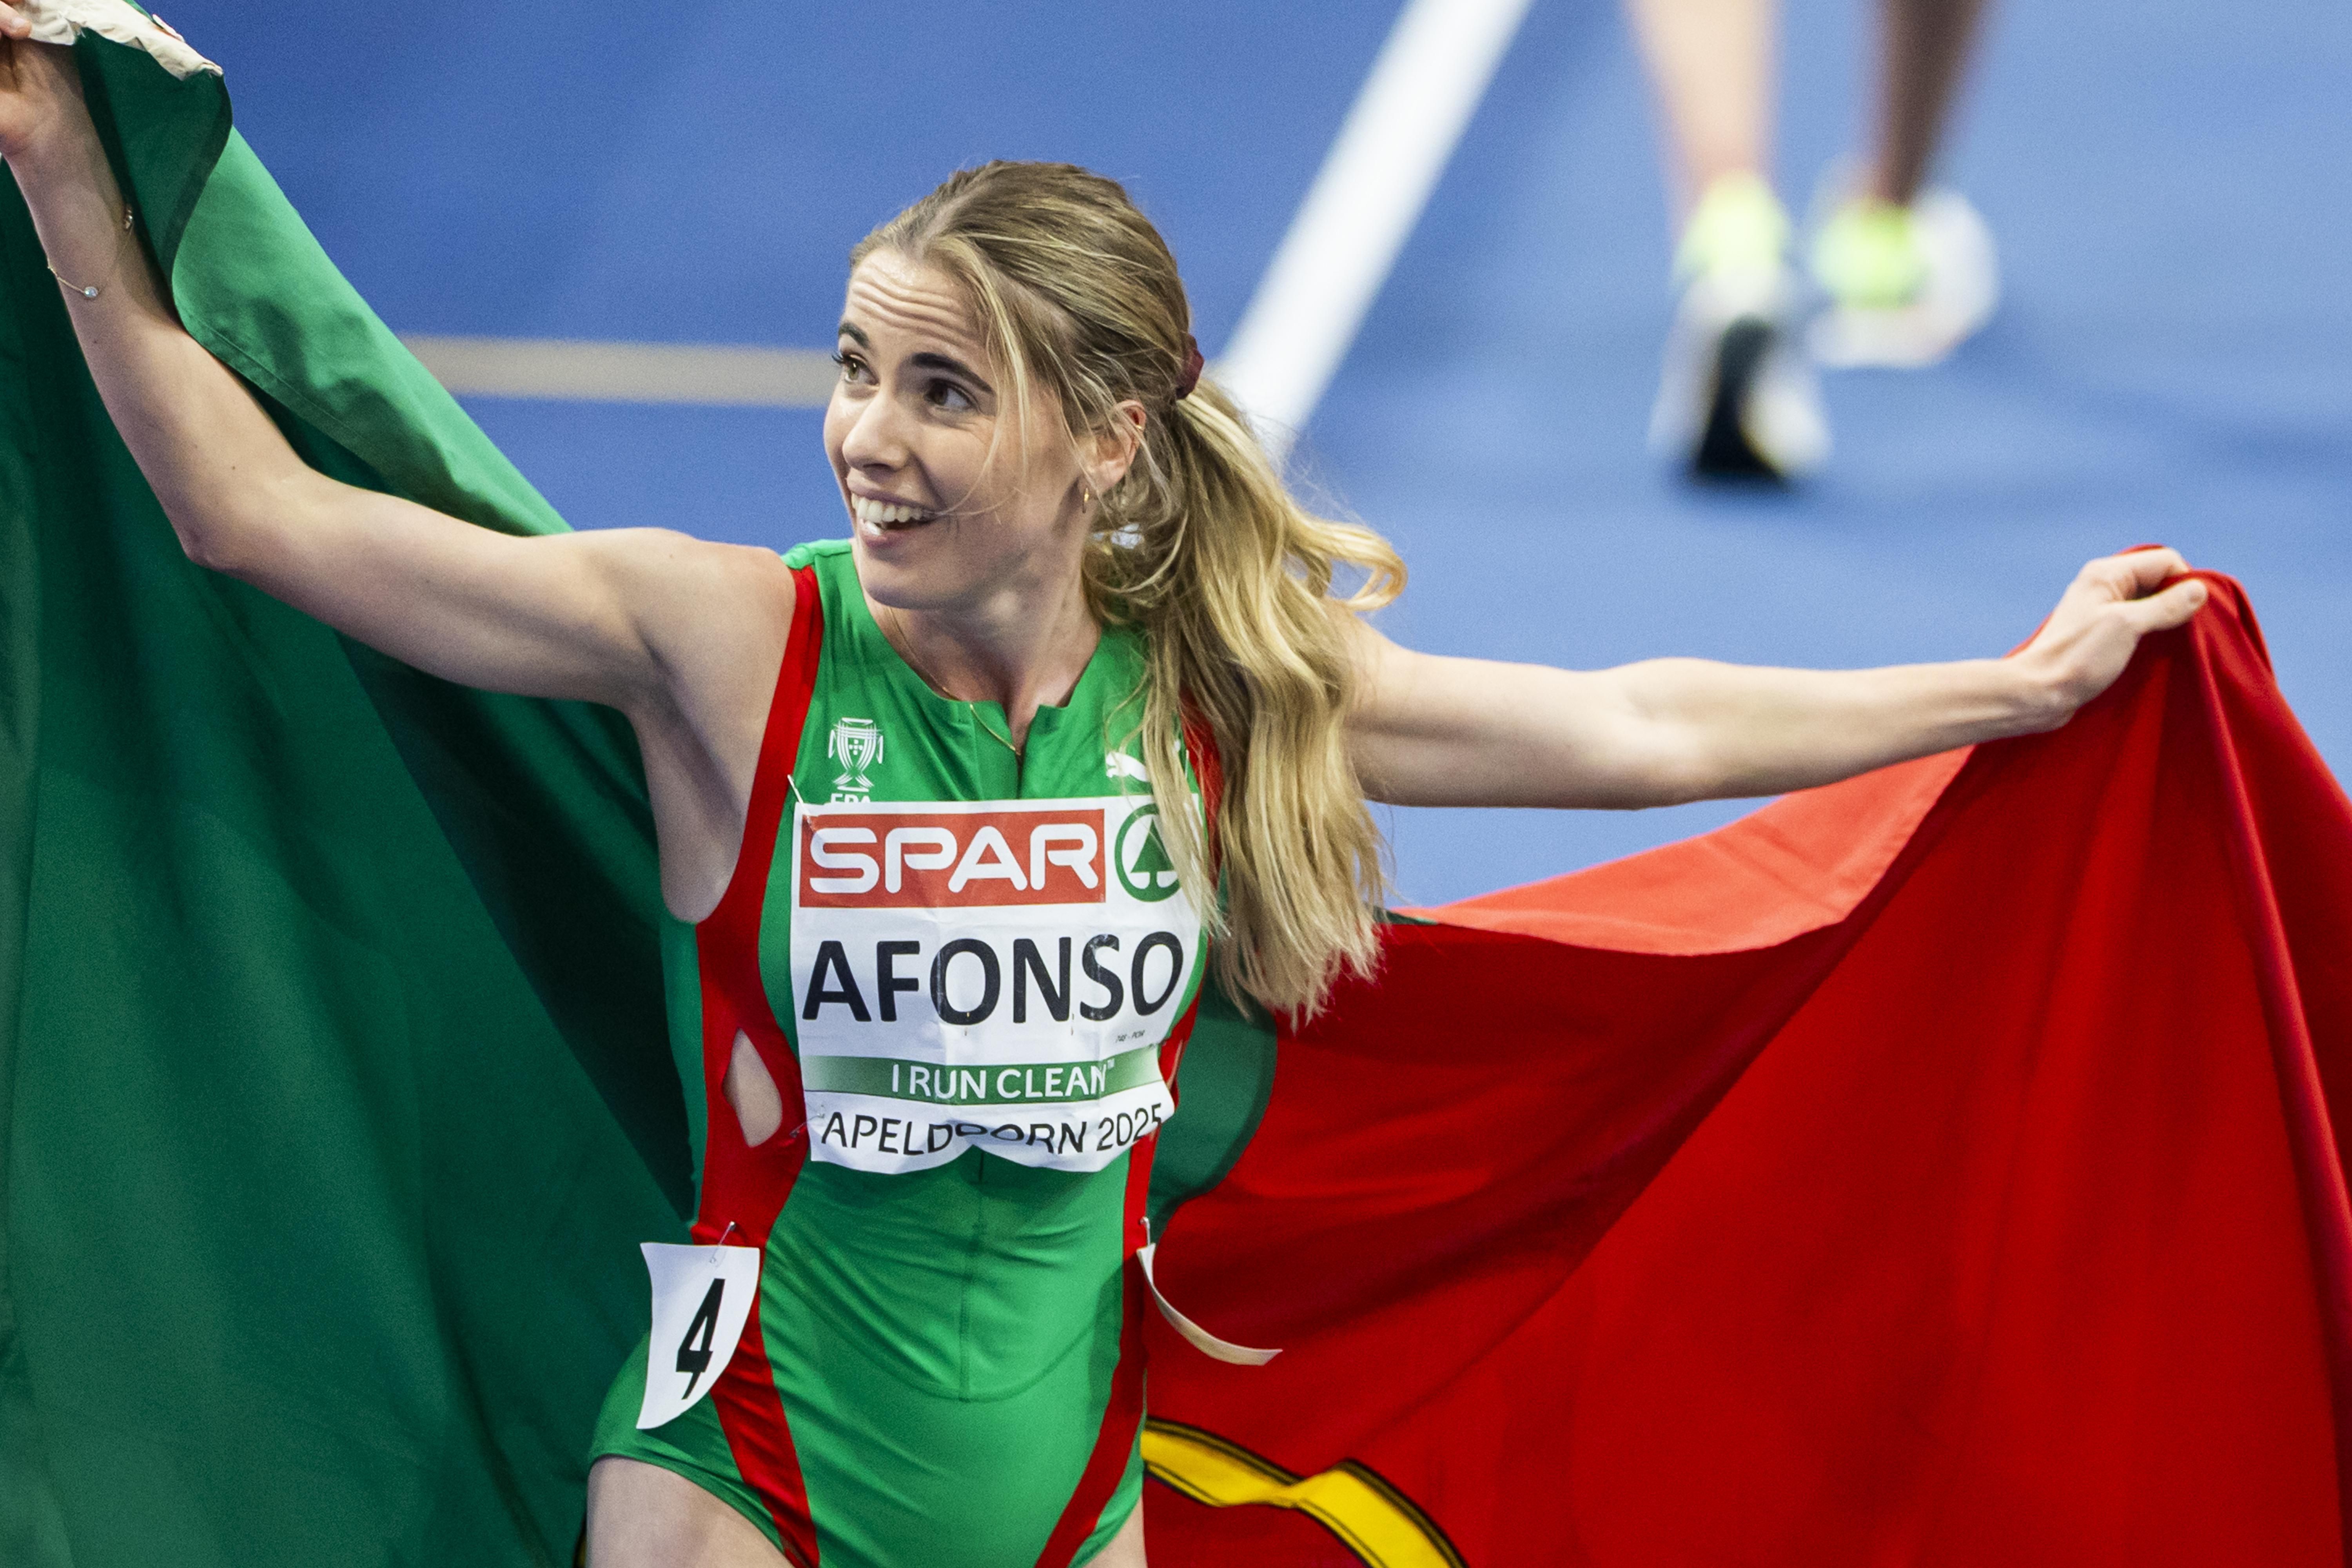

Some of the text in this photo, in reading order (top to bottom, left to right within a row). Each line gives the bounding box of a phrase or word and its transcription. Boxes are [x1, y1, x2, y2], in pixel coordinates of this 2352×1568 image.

[810, 824, 1098, 894] SPAR
[802, 931, 1184, 1025] AFONSO
[892, 1064, 1107, 1099] I RUN CLEAN
[821, 1102, 1161, 1155] APELDOORN 2025
[675, 1278, 726, 1400] 4
